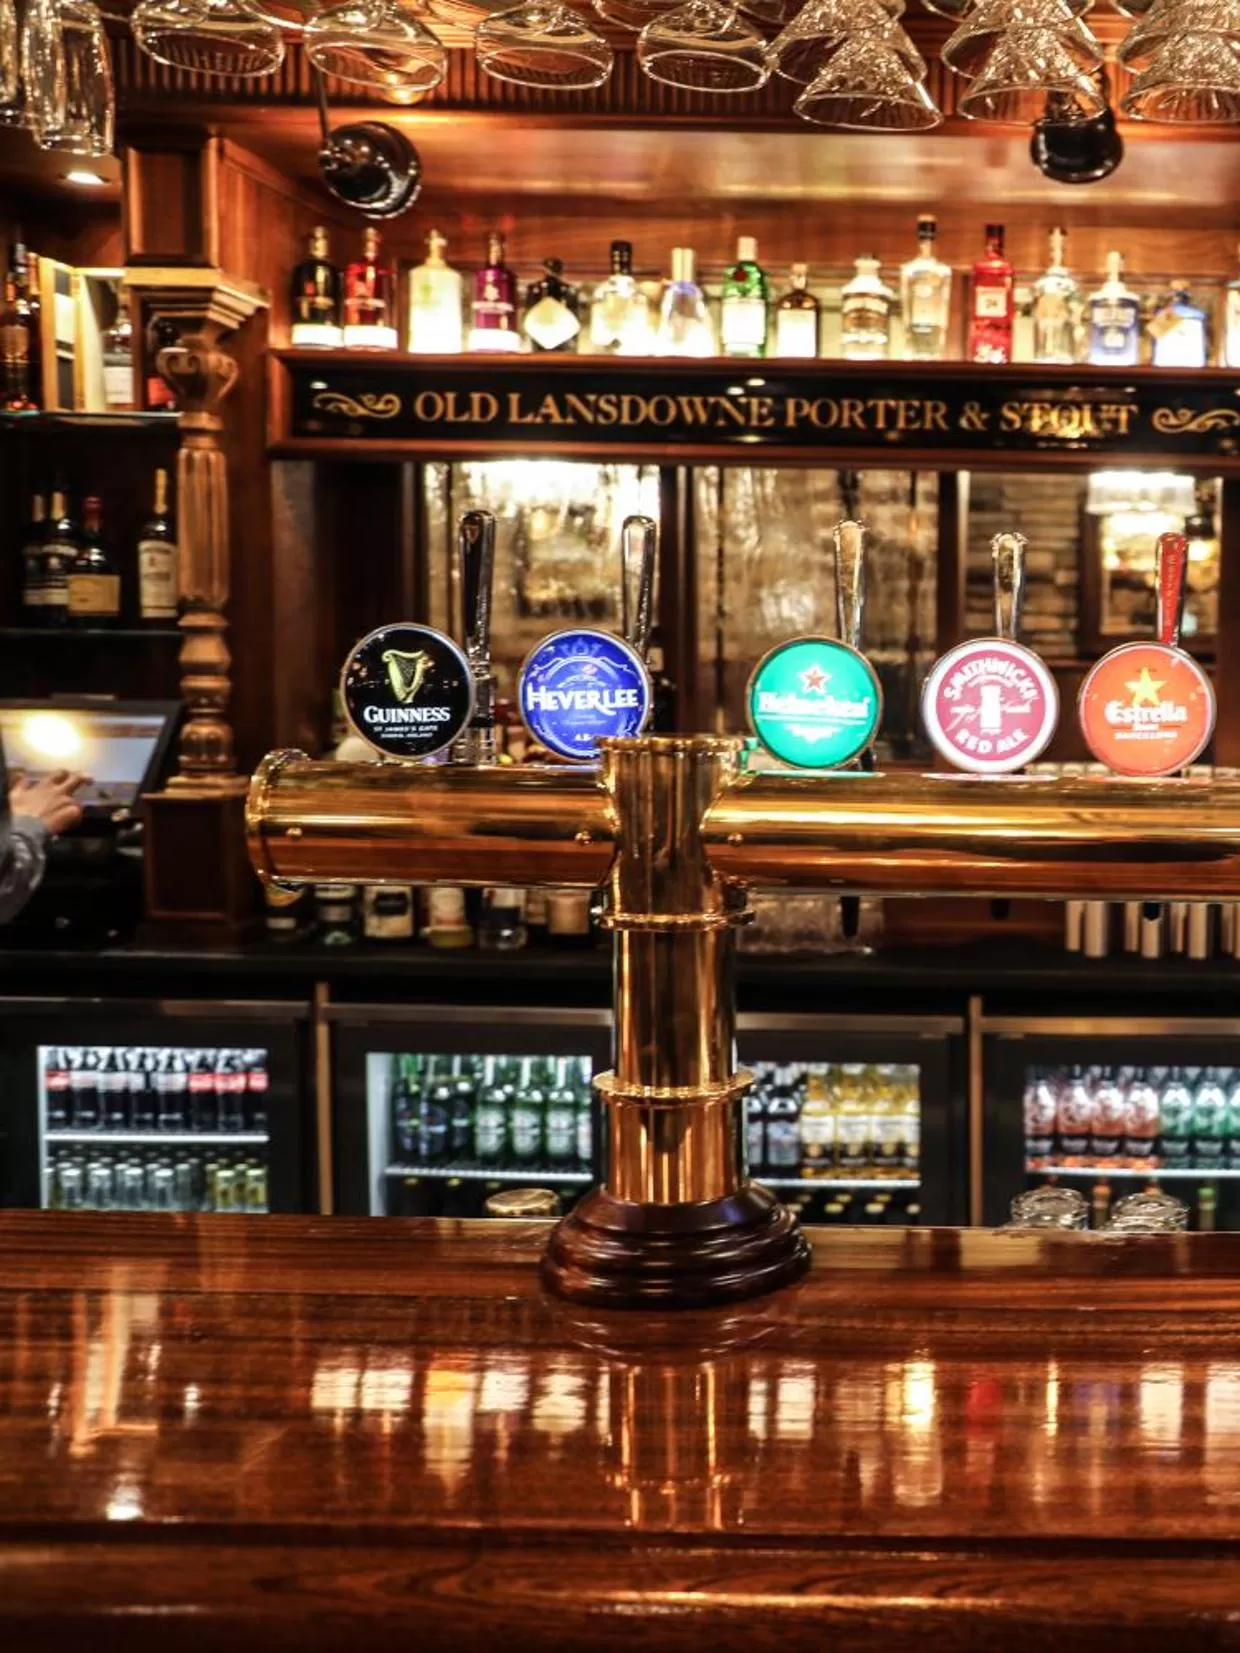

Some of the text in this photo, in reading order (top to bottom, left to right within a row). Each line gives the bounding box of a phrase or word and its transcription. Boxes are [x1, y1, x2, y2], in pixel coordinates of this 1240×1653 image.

[414, 391, 1138, 435] OLD LANSDOWNE PORTER & STOUT
[363, 705, 451, 723] GUINNESS
[527, 682, 639, 716] HEVERLEE
[955, 728, 993, 754] RED
